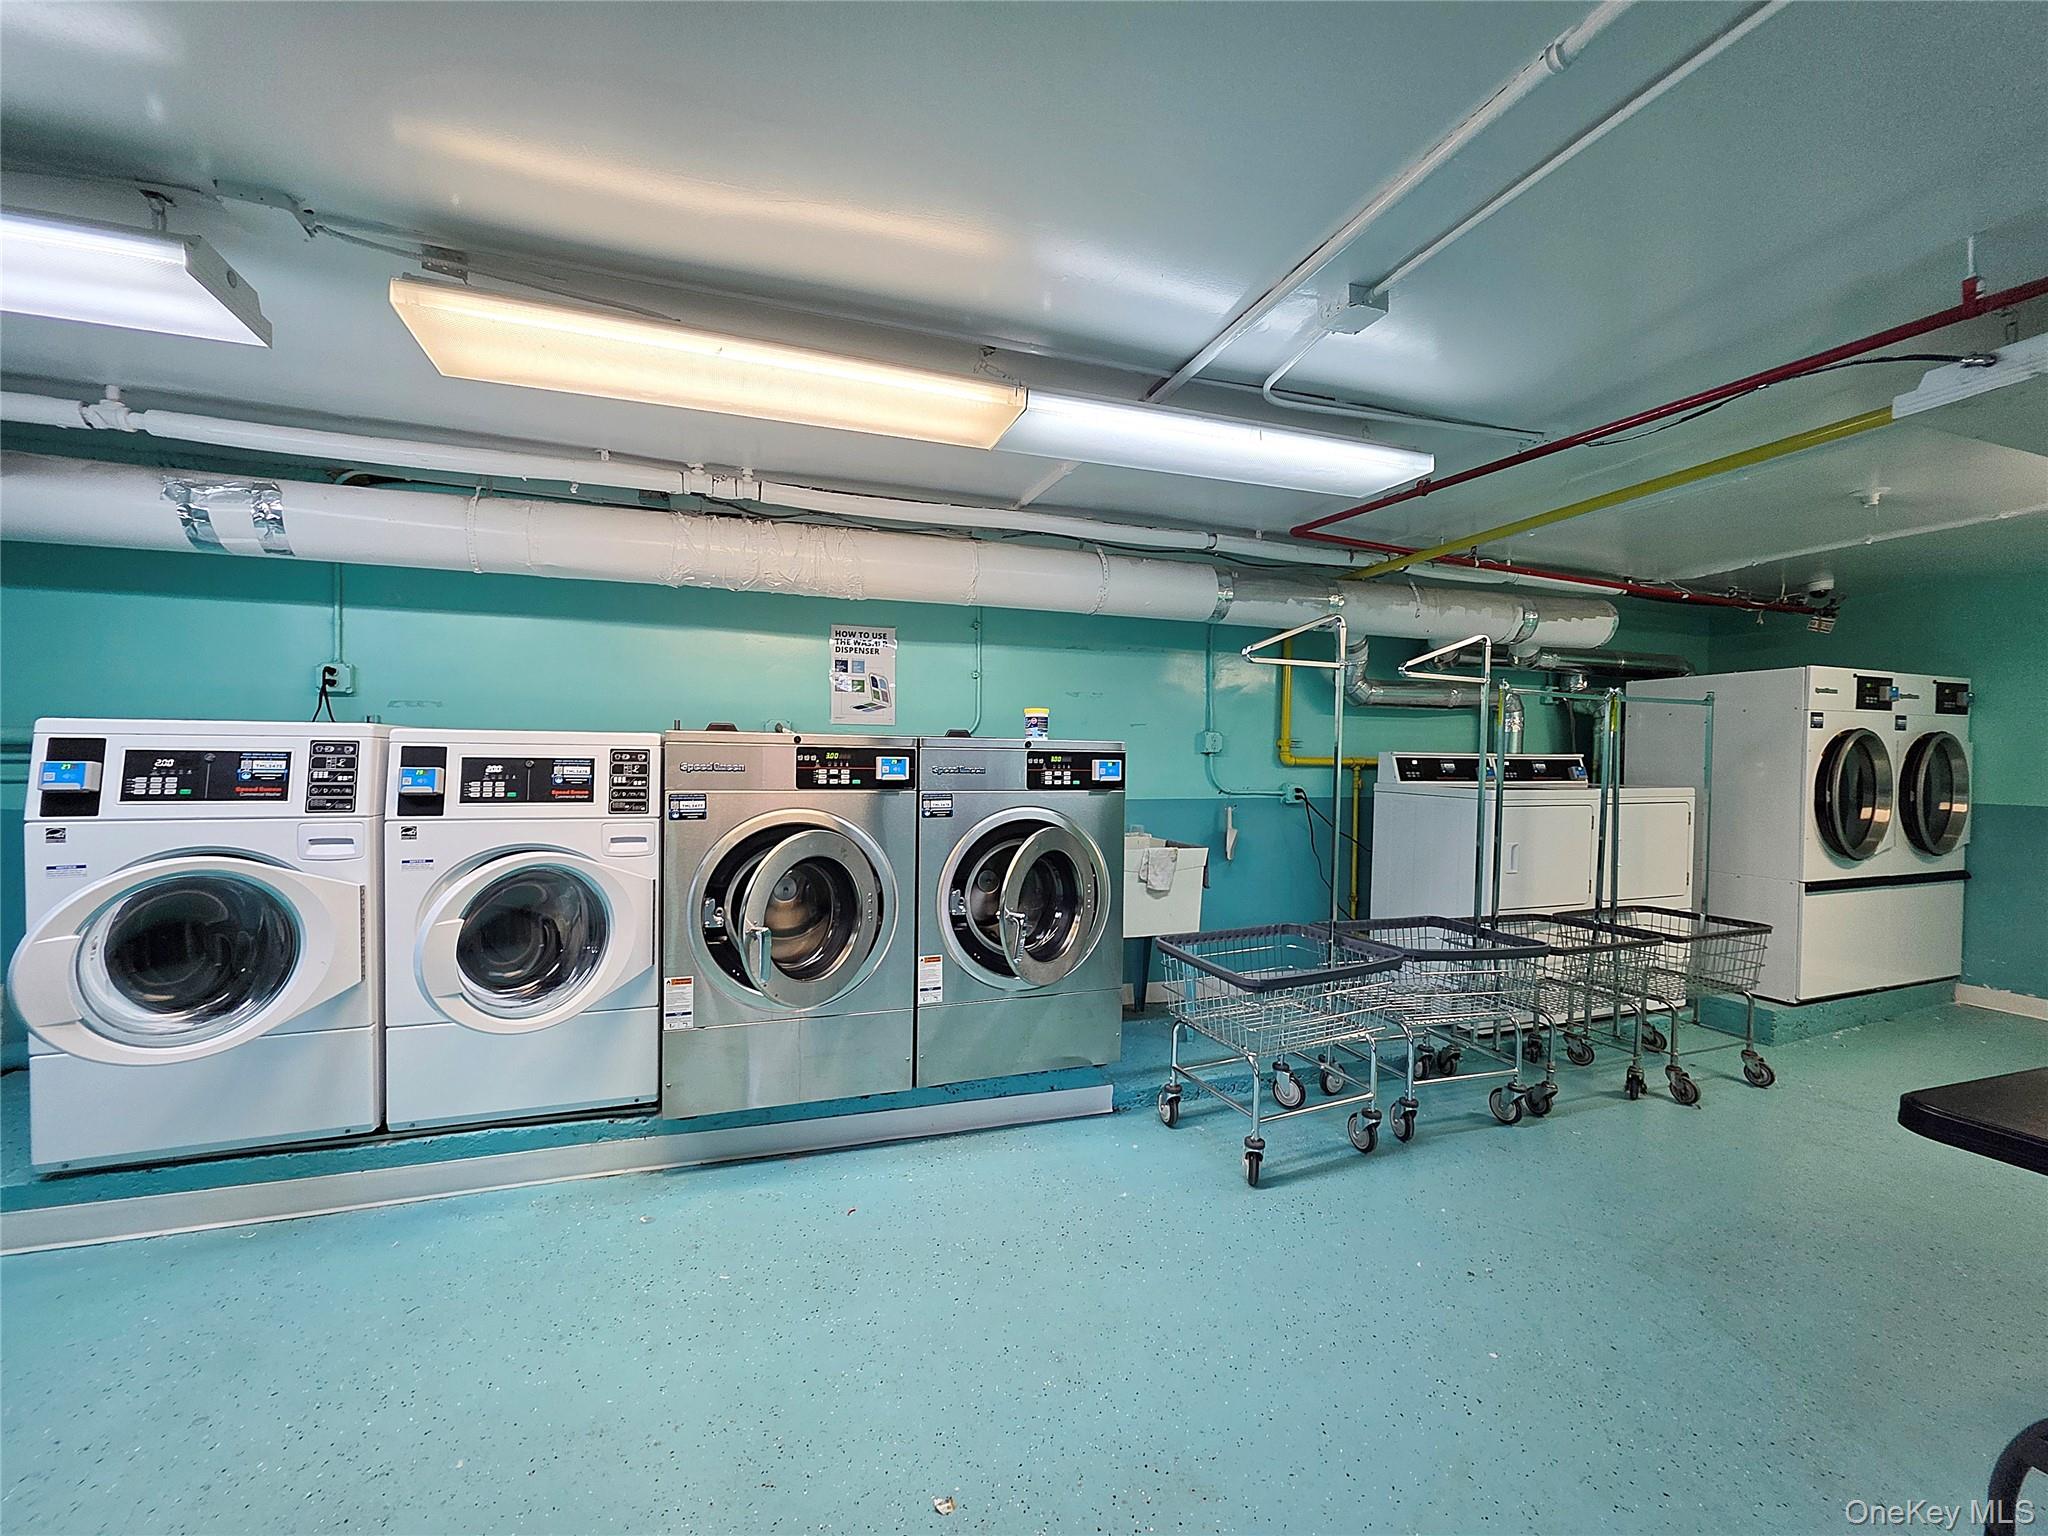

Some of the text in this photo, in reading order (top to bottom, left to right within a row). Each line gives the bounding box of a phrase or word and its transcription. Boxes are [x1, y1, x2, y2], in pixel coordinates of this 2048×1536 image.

[835, 630, 888, 640] HOW TO USE
[835, 638, 851, 646] THE
[835, 646, 880, 655] DISPENSER
[680, 761, 746, 773] Speed Queen
